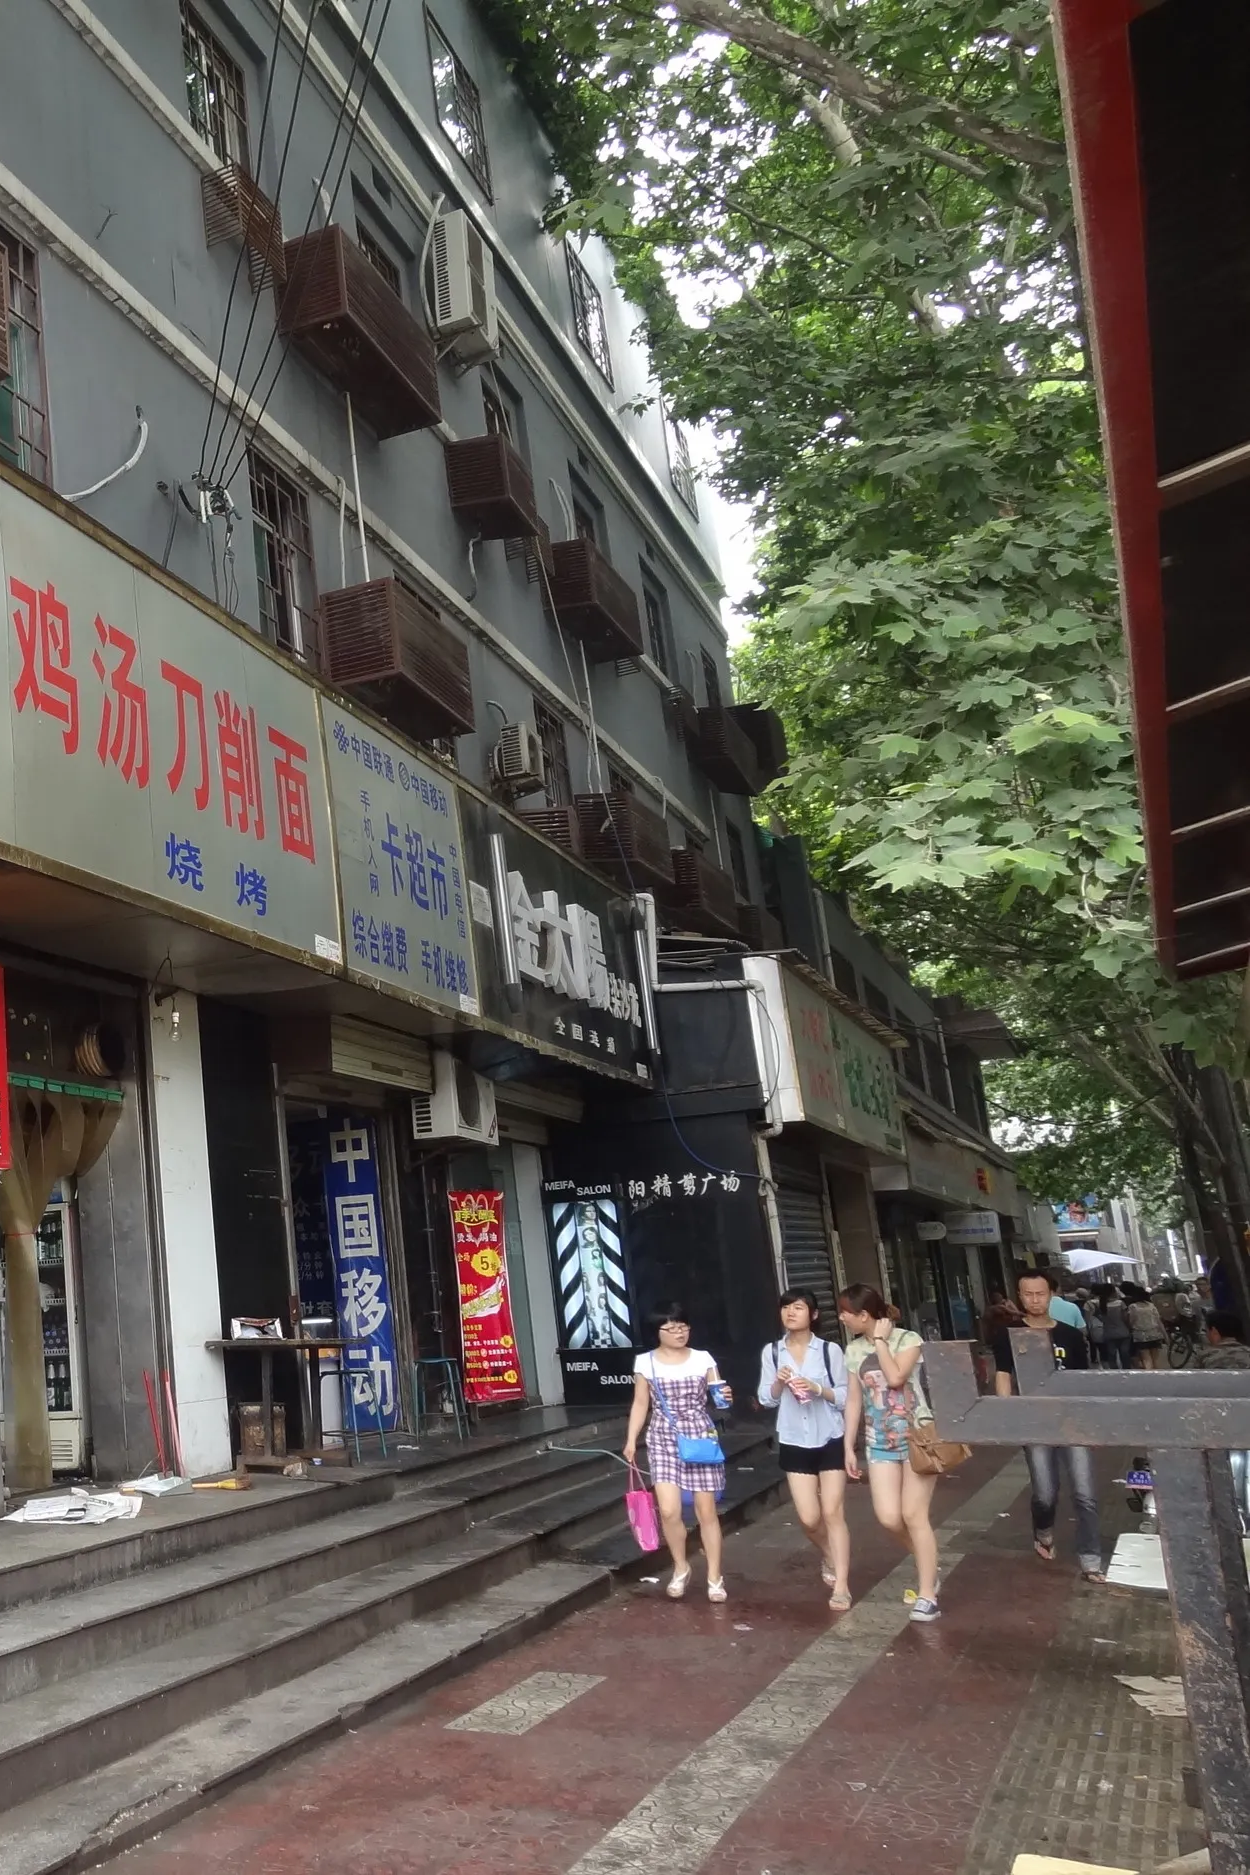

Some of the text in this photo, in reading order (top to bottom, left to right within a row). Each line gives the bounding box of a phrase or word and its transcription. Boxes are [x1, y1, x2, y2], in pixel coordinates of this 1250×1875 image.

[10, 576, 316, 865] 鸡汤刀削面
[350, 733, 448, 818] 中国联通 中国移动
[165, 832, 268, 916] 烧烤
[360, 790, 379, 897] 手机入网
[381, 812, 449, 920] 卡超市
[449, 843, 466, 939] 中国电信
[351, 908, 469, 995] 综合缴费 手机维修
[545, 1179, 611, 1196] MEIFA SALON
[329, 1118, 394, 1416] 中国移动
[566, 1362, 598, 1372] MEIFA
[600, 1375, 635, 1385] SALON
